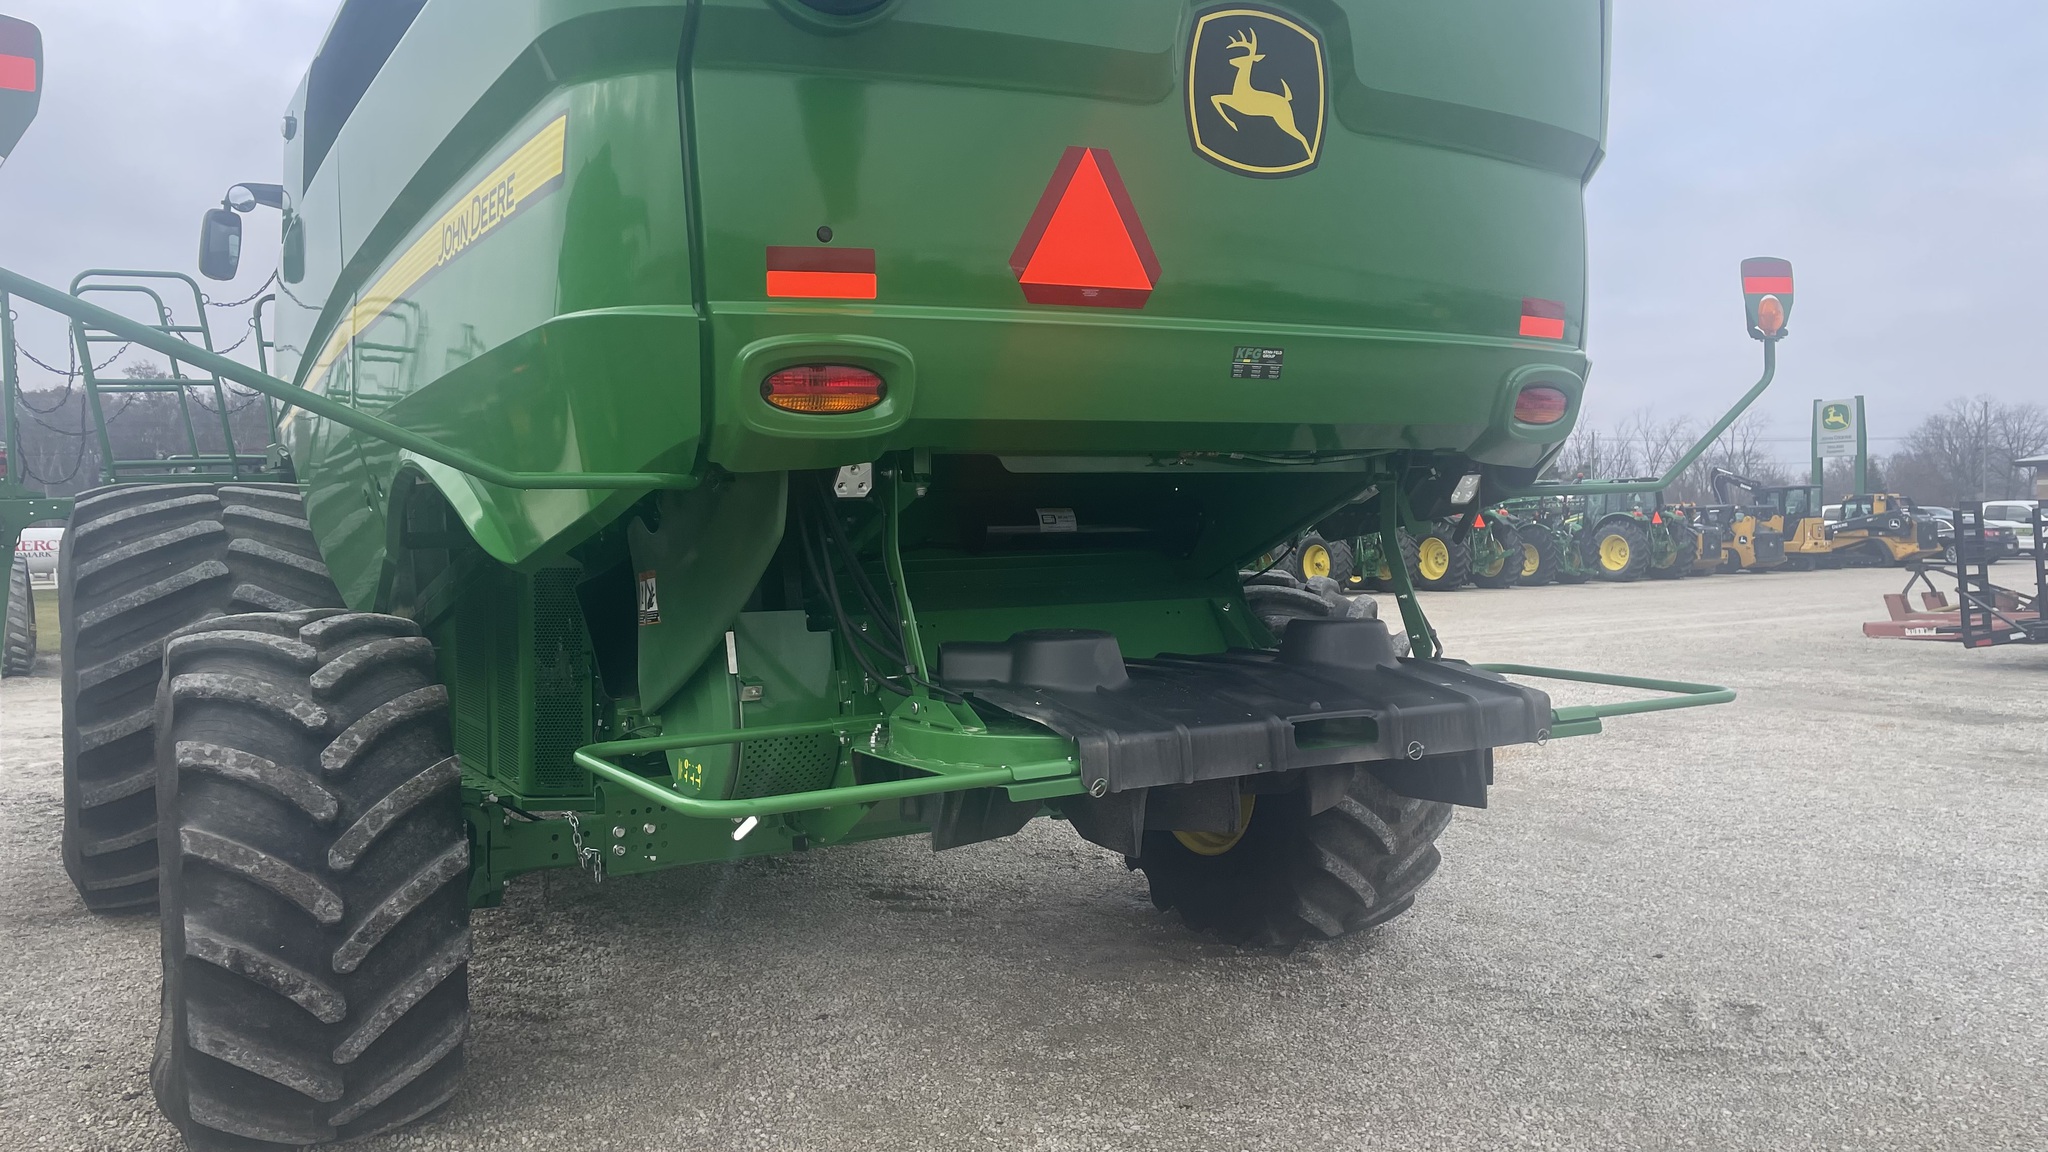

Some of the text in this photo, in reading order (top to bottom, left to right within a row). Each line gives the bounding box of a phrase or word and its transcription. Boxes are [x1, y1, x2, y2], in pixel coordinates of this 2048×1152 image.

[438, 172, 516, 263] JOHN DEERE
[1235, 348, 1262, 359] KFG
[1831, 522, 1848, 530] DEERE
